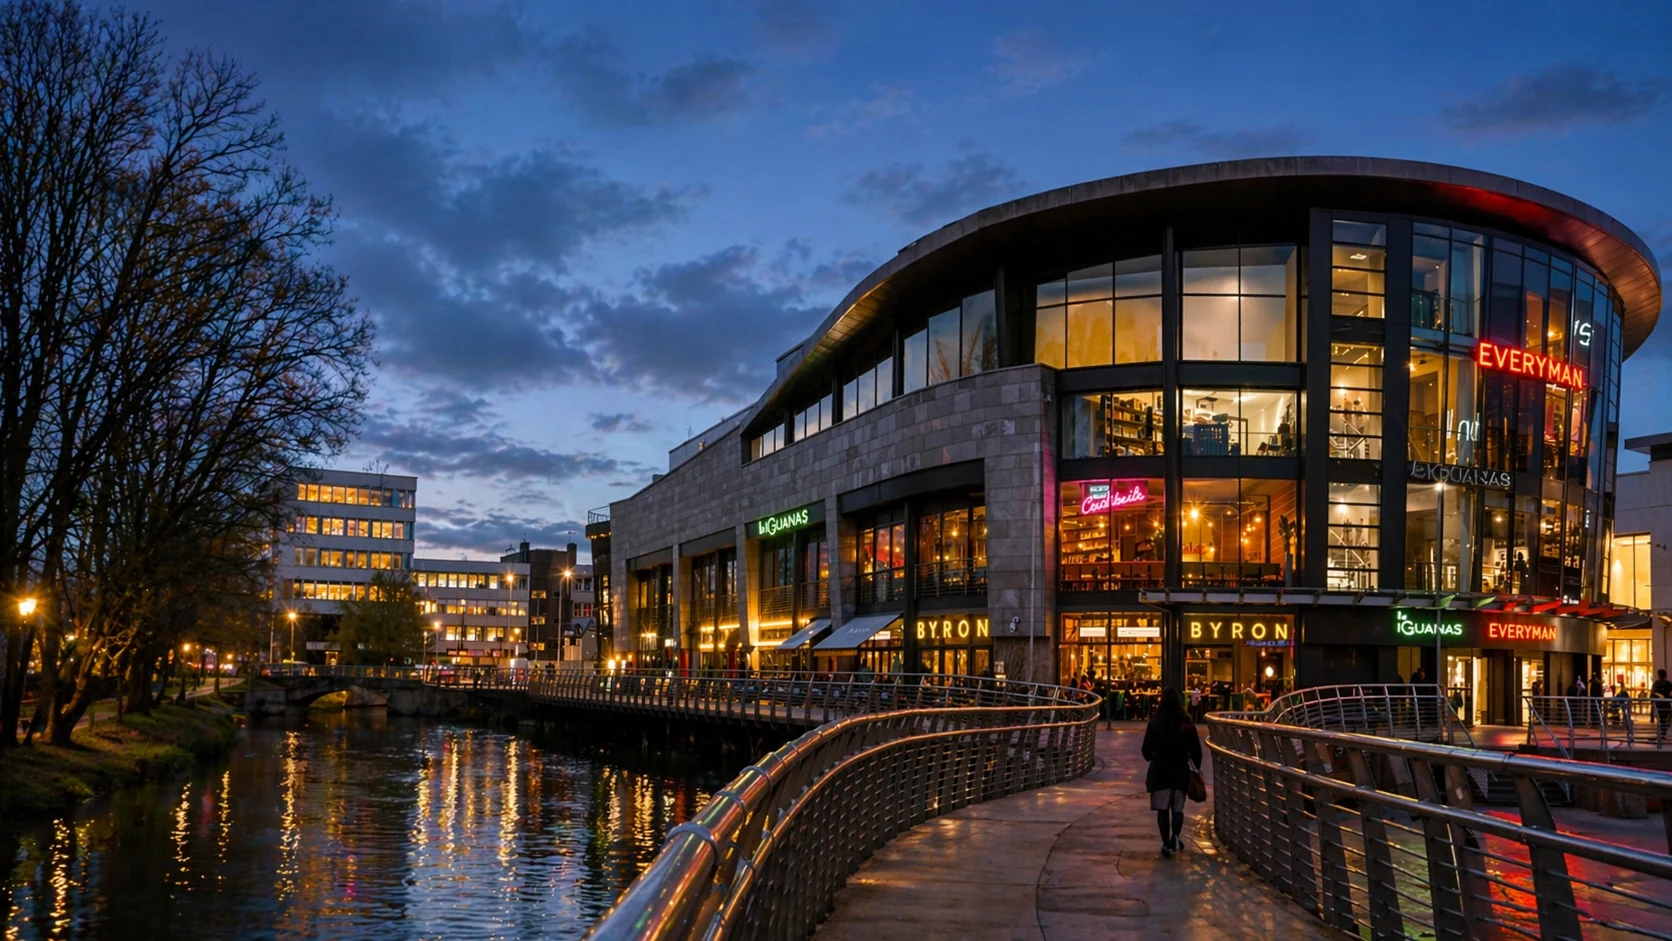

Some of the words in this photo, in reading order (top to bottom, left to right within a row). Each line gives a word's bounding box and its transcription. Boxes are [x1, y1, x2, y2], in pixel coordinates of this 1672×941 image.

[1479, 342, 1583, 389] EVERYMAN
[917, 619, 989, 640] BYRON
[1190, 621, 1288, 640] BYRON
[1397, 620, 1463, 636] IGUANAS
[1489, 622, 1557, 640] EVERYMAN
